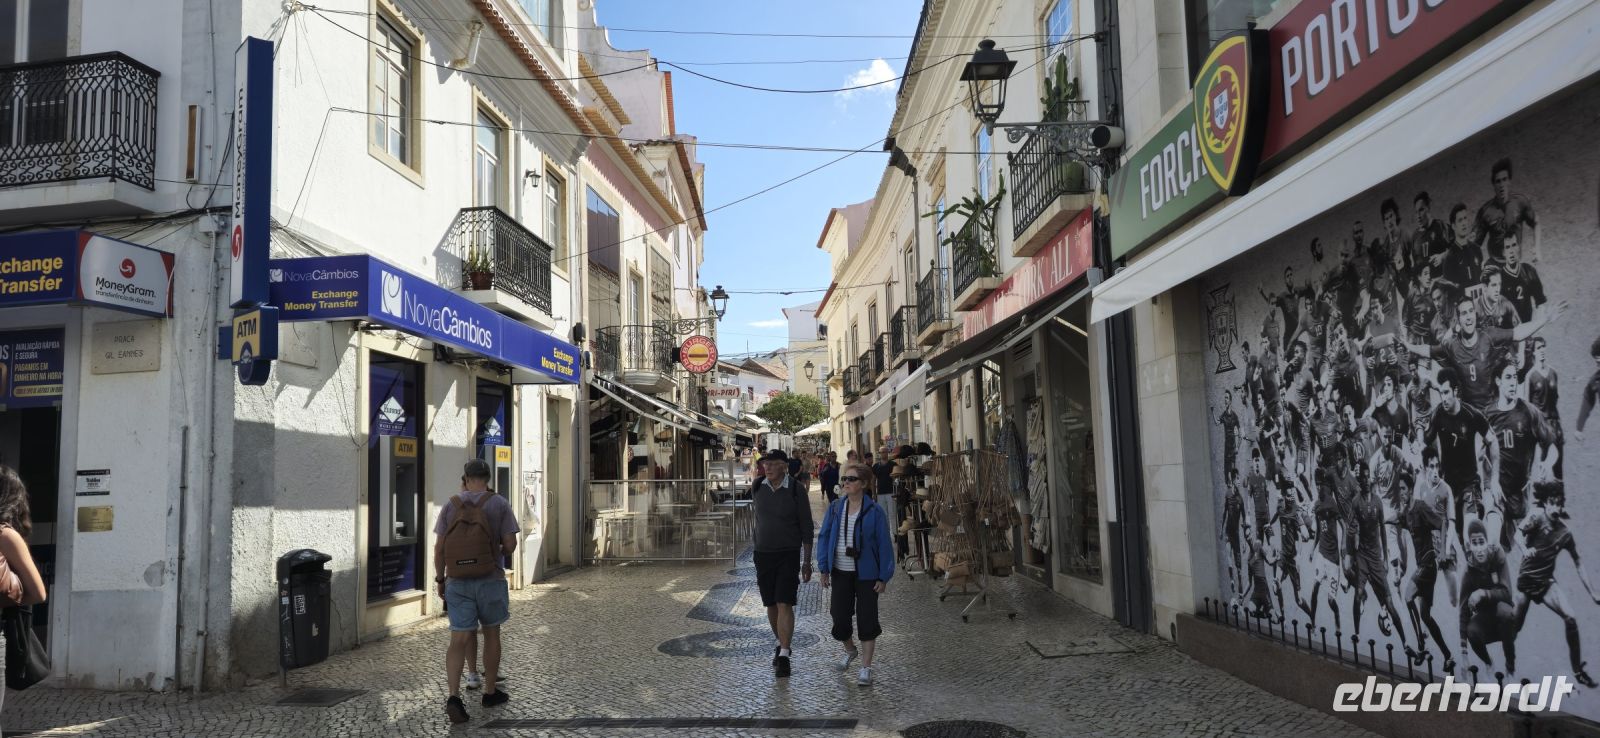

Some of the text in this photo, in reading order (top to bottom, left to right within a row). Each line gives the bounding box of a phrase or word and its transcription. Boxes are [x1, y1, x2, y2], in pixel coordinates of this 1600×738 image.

[234, 87, 244, 219] MoneyGram
[1140, 123, 1207, 219] FORÇA
[0, 257, 63, 275] change
[1050, 233, 1073, 290] ALL
[284, 269, 359, 281] NovaCâmbios
[0, 276, 63, 294] ransfer
[95, 276, 156, 298] MoneyGram
[312, 289, 359, 299] Exchange
[1516, 285, 1524, 300] 2
[284, 300, 359, 312] Money Transfer
[236, 318, 257, 339] ATM
[404, 290, 492, 349] NovaCâmbios
[682, 337, 714, 354] BURGER
[553, 347, 574, 366] Exchange
[682, 357, 715, 372] RANCH
[541, 356, 574, 377] Money Transfer
[1469, 363, 1477, 382] 9
[398, 442, 414, 453] ATM
[1451, 433, 1458, 447] 7
[1502, 429, 1514, 449] 10
